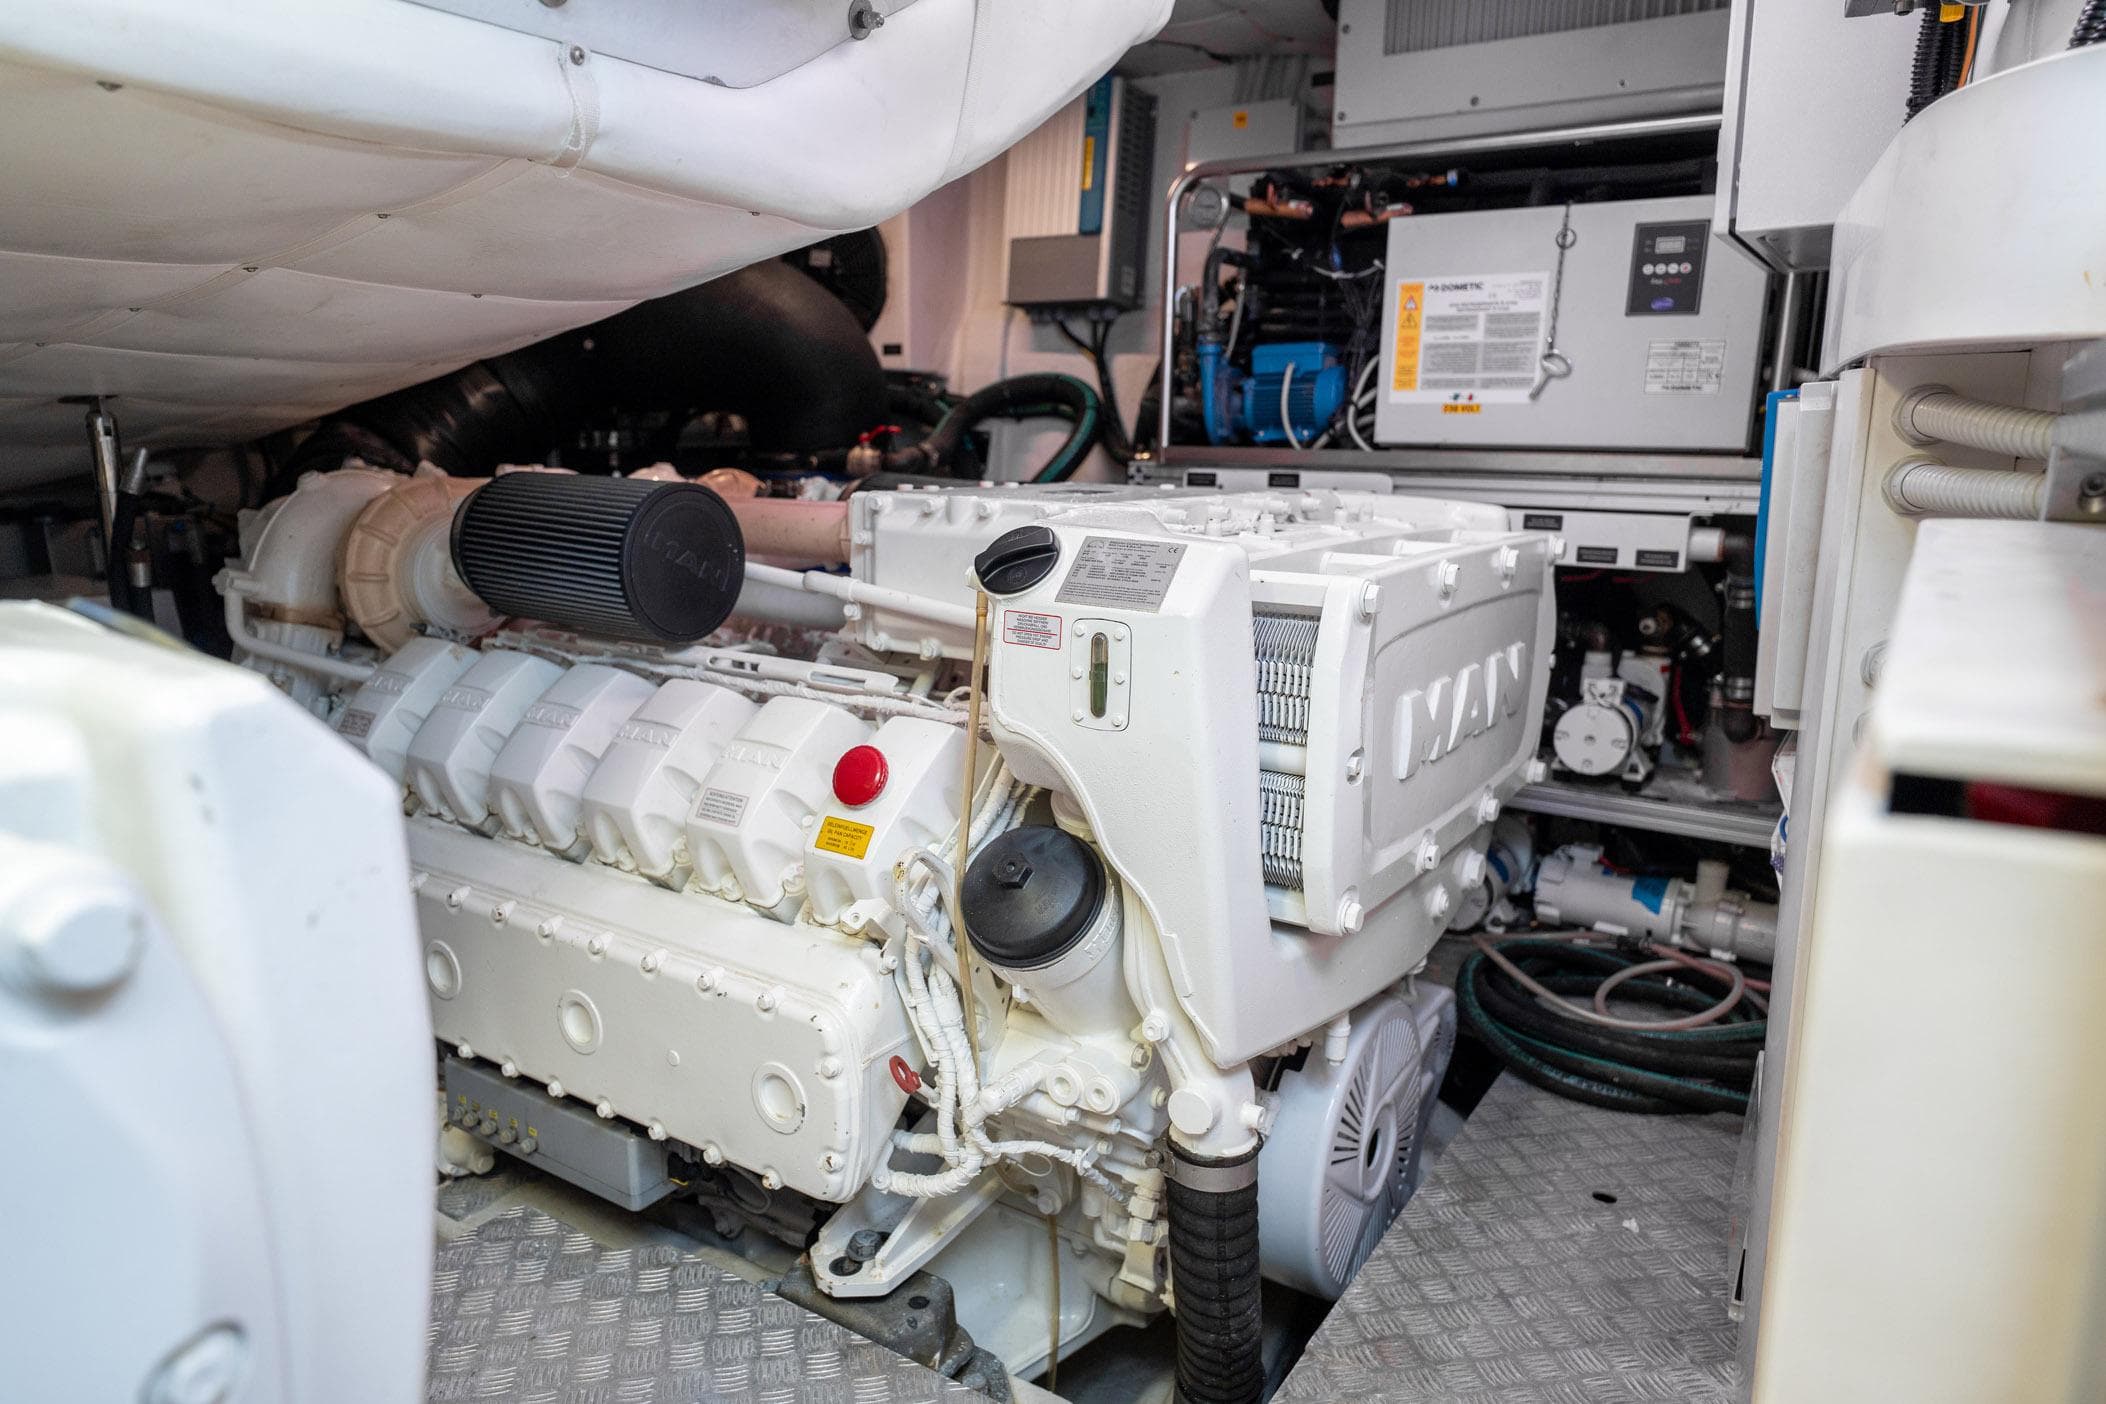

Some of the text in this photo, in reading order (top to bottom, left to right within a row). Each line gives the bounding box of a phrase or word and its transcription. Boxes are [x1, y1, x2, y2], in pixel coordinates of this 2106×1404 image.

[442, 688, 492, 711] MAN
[1392, 640, 1526, 781] MAN
[526, 705, 581, 728] MAN
[616, 725, 681, 748] MAN
[721, 744, 788, 769] MAN
